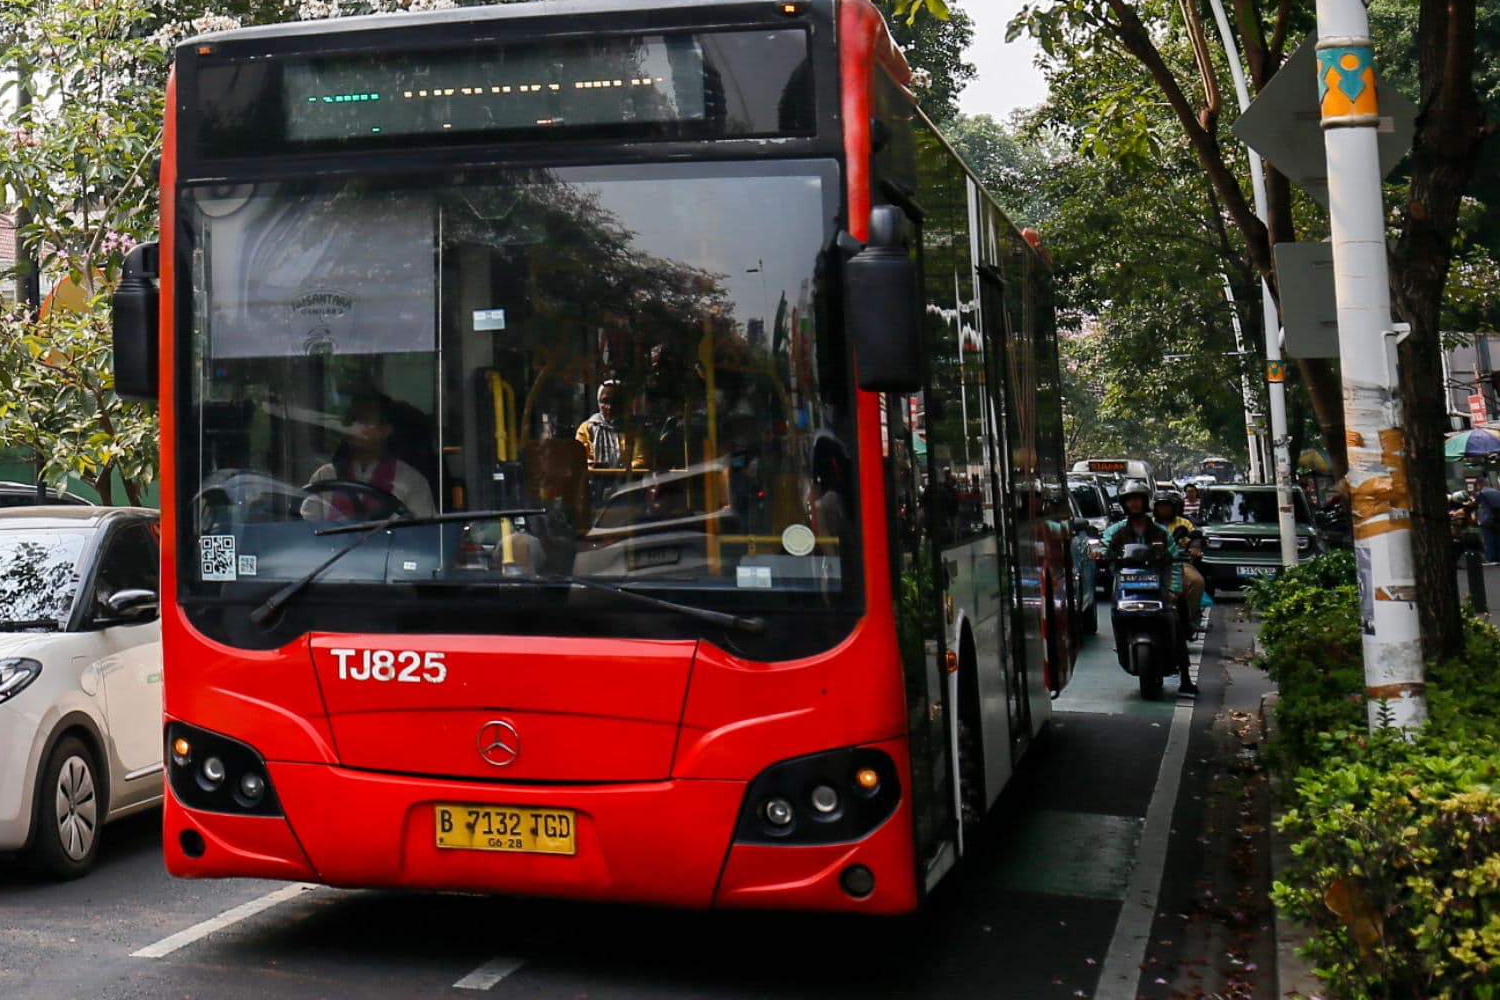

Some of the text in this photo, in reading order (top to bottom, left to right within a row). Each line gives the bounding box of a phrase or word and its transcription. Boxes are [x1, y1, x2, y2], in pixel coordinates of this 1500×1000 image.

[330, 648, 448, 684] TJ825
[440, 809, 571, 838] B 7132 TGD
